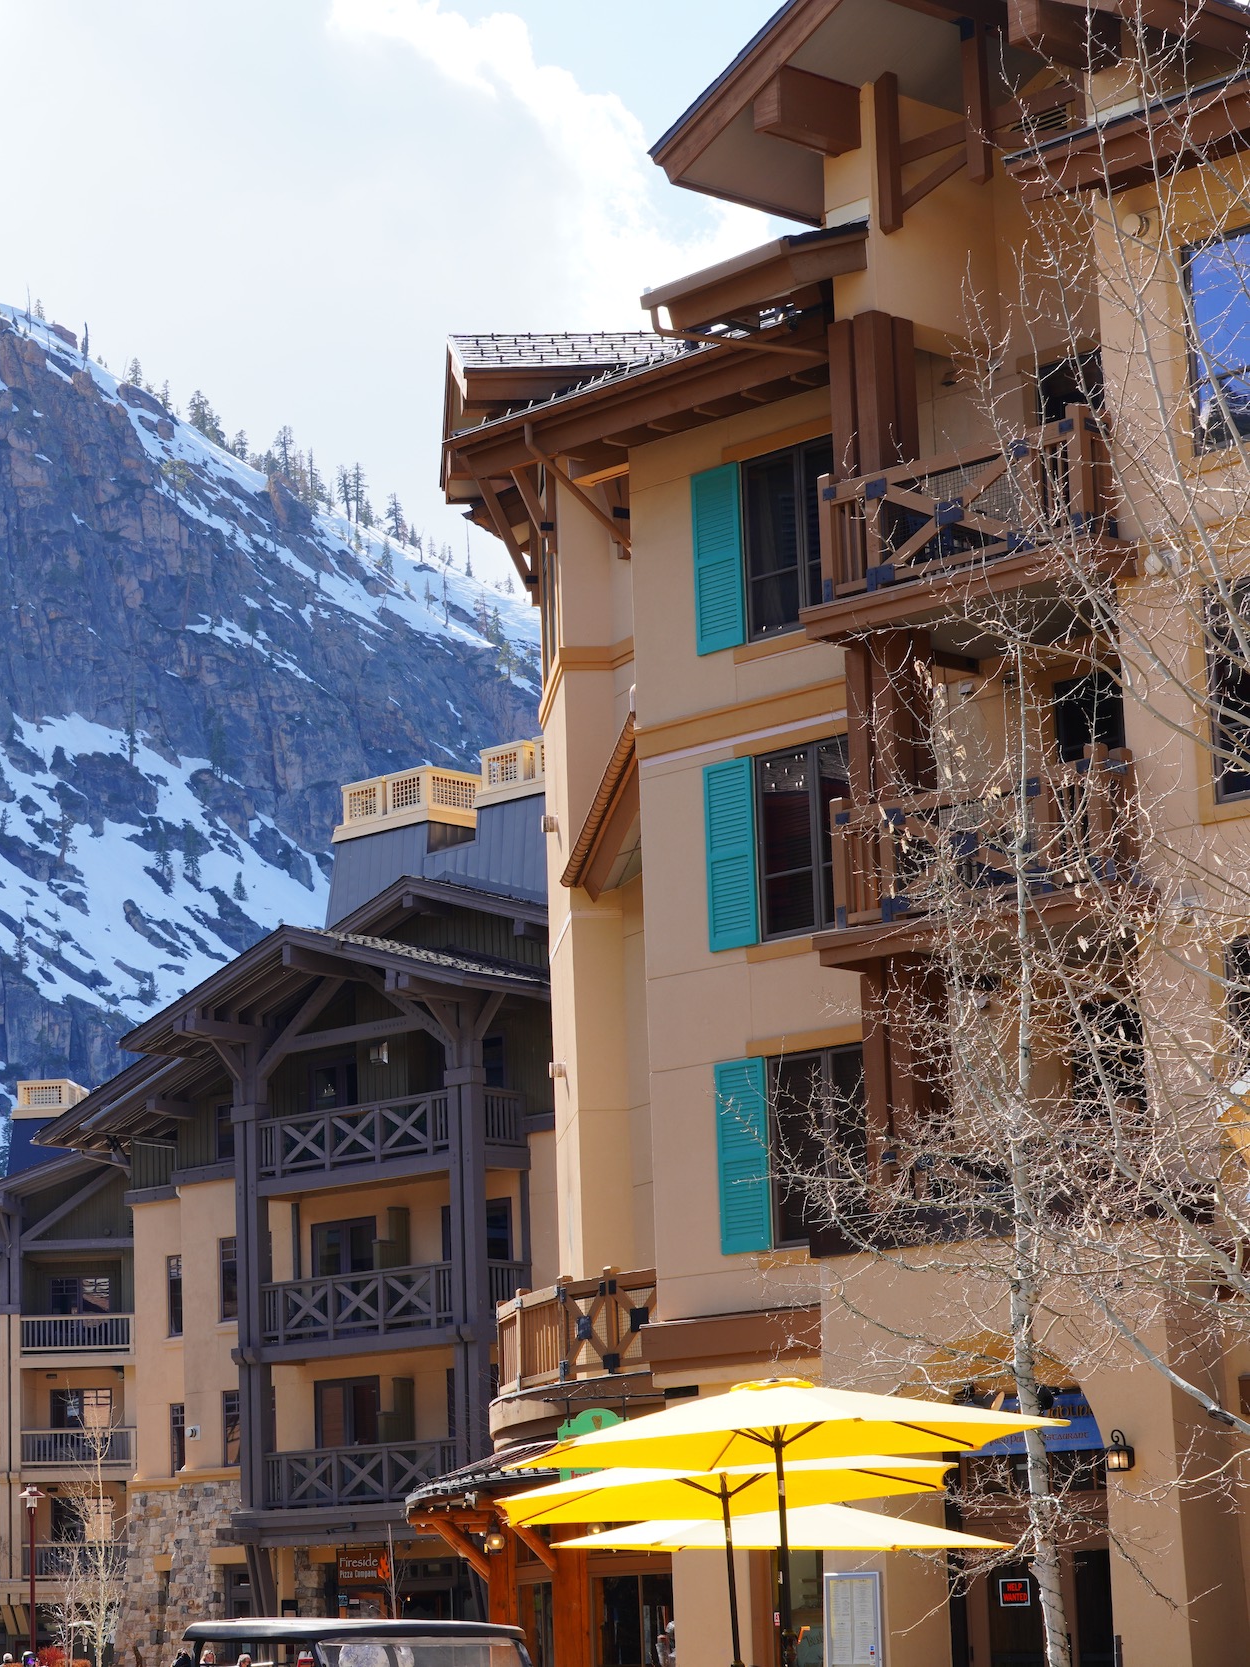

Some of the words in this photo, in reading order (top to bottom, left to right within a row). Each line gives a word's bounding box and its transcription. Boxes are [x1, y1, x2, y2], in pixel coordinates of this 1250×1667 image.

[340, 1553, 378, 1567] Fireside
[340, 1570, 353, 1579] Pizza
[355, 1570, 377, 1579] Company
[1006, 1582, 1023, 1592] HELP
[1003, 1592, 1028, 1602] WANTED
